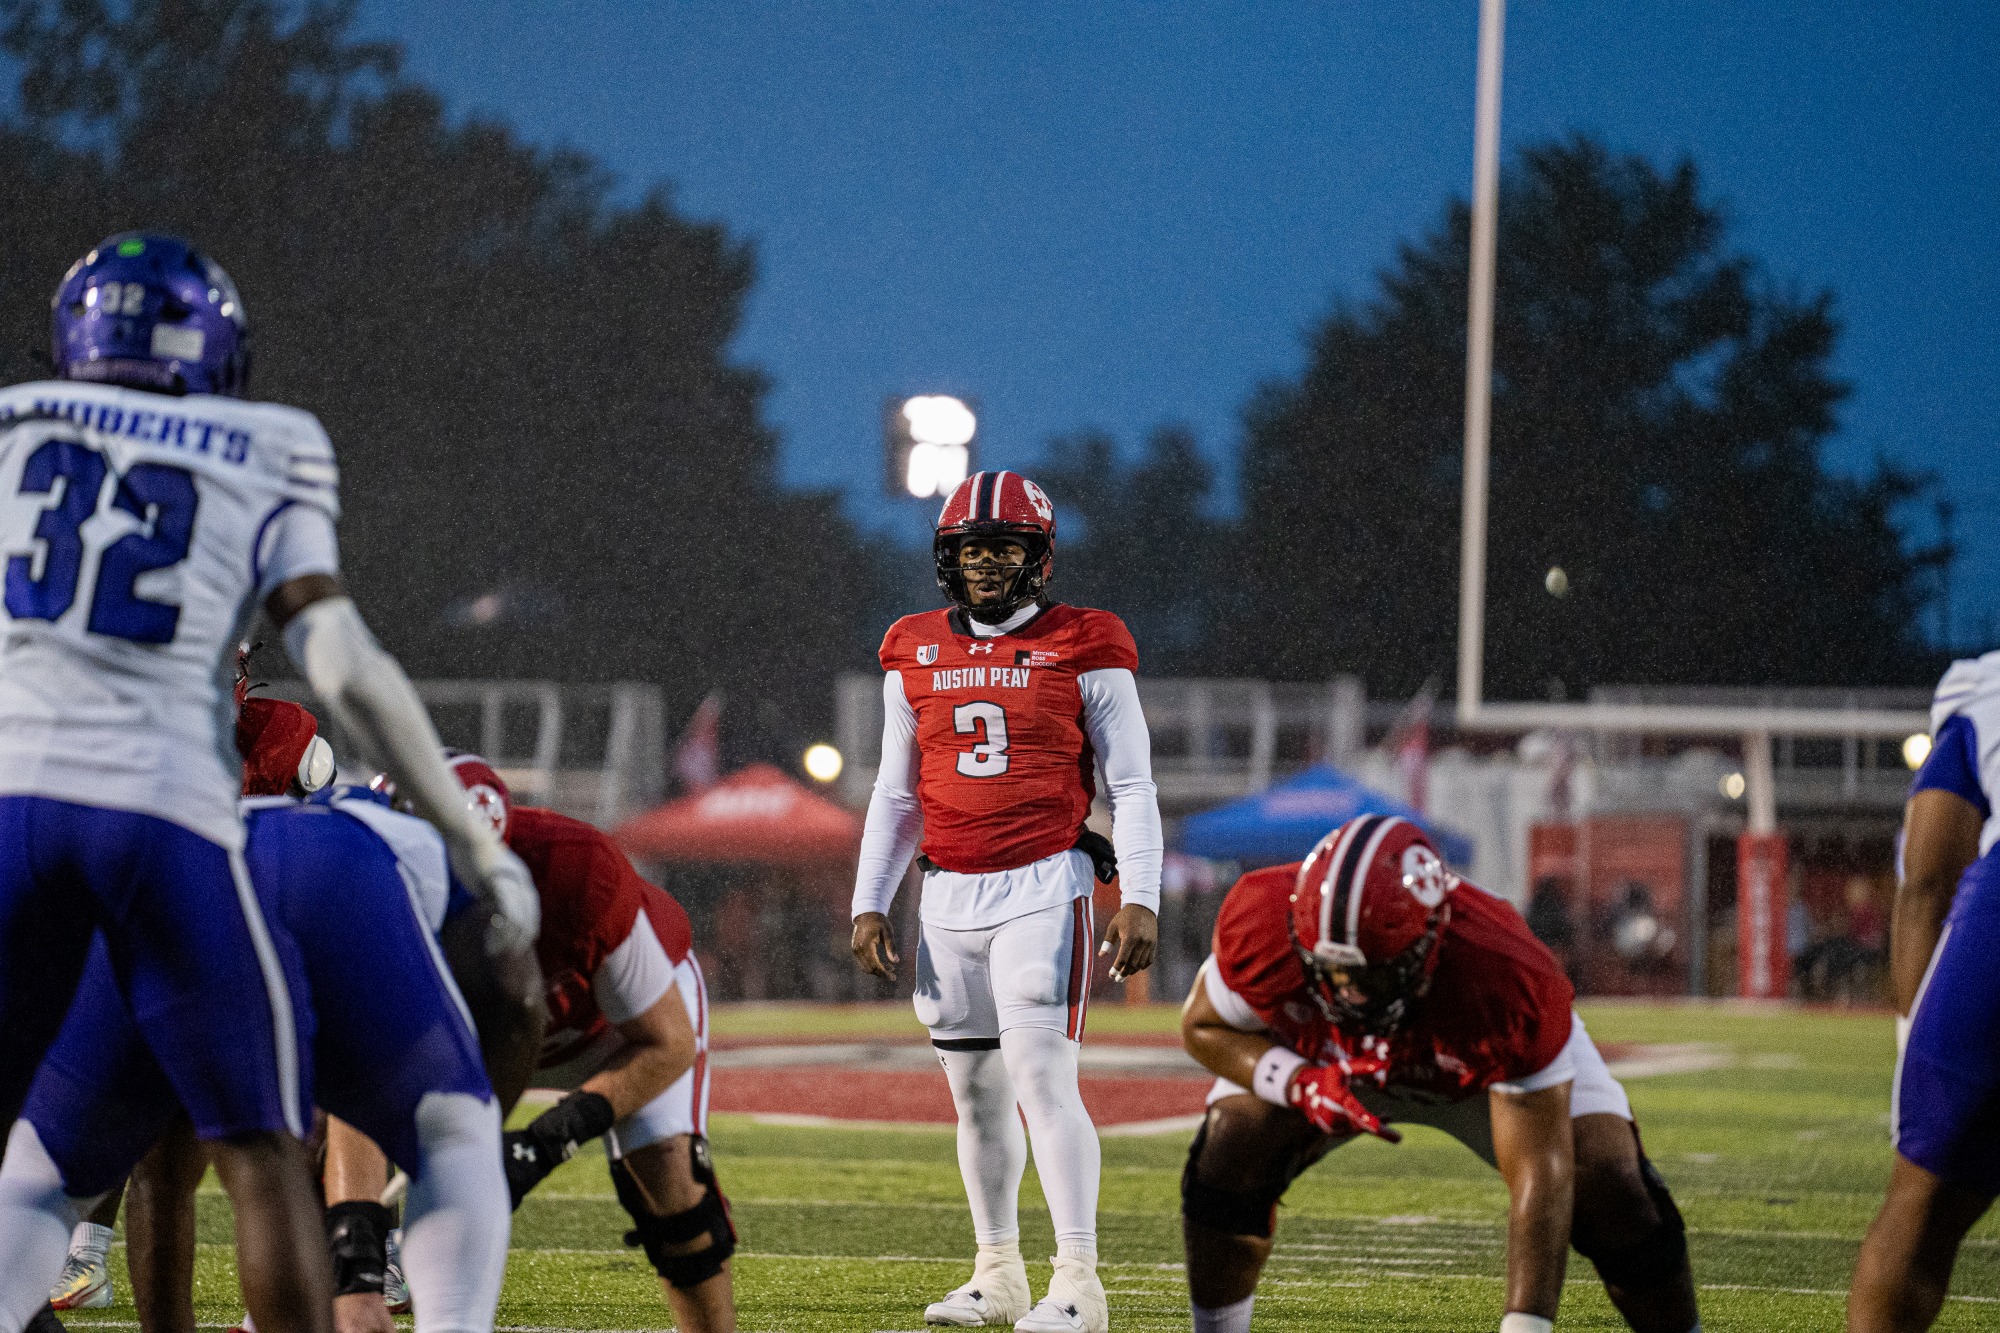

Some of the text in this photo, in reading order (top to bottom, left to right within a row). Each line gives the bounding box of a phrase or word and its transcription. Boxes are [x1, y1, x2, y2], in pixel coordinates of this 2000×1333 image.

[4, 439, 199, 644] 32
[932, 667, 1031, 692] AUSTIN PEAY
[953, 700, 1010, 779] 3
